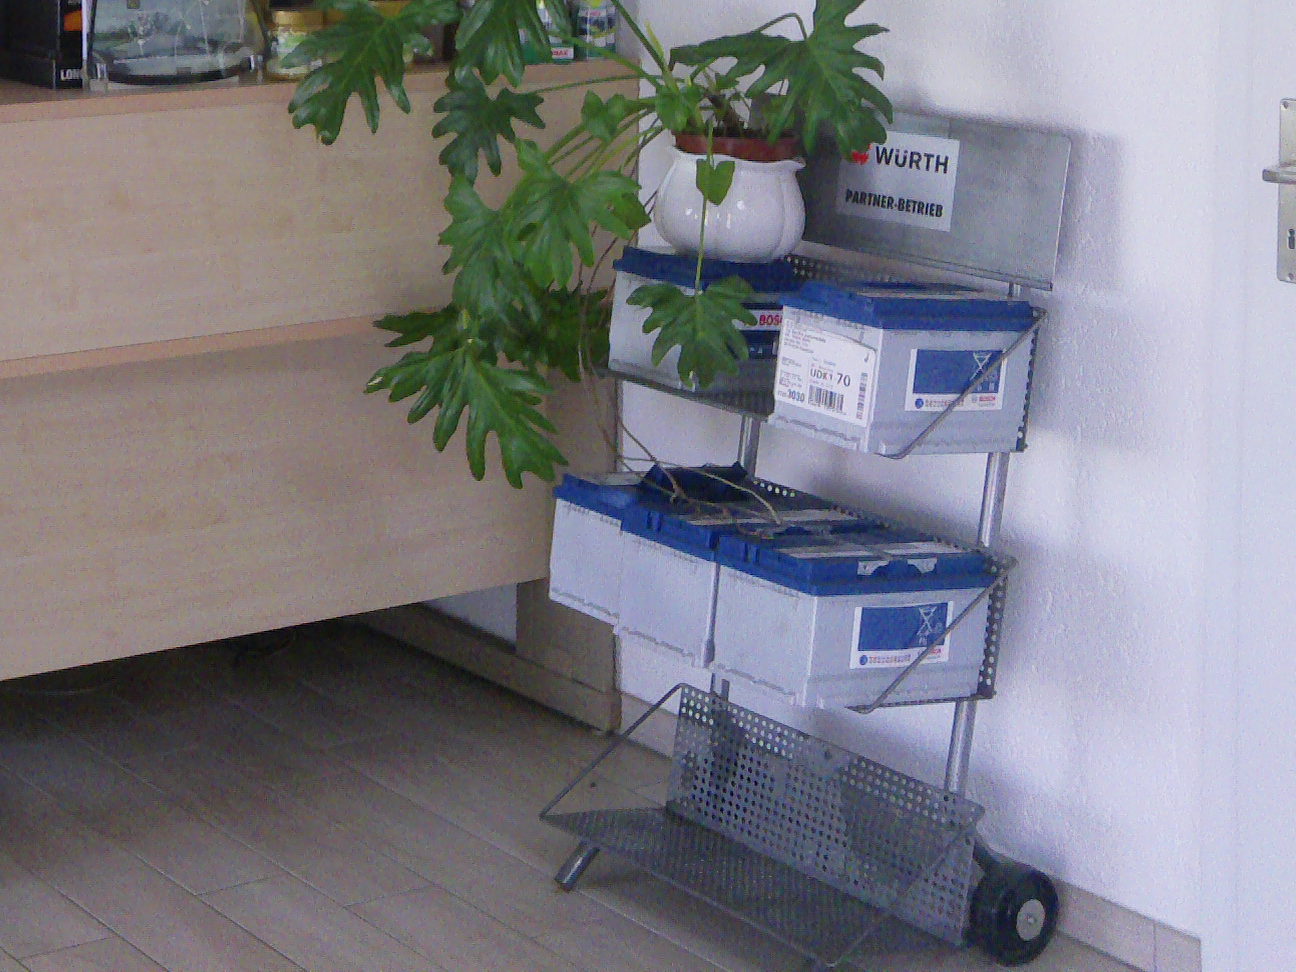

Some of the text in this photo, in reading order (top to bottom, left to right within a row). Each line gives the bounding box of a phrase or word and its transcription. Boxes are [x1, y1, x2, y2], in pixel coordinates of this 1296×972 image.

[875, 146, 950, 174] WÜRTH
[845, 188, 944, 218] PARTNER-BETRIEB
[759, 315, 782, 326] BOS
[837, 372, 851, 387] 70
